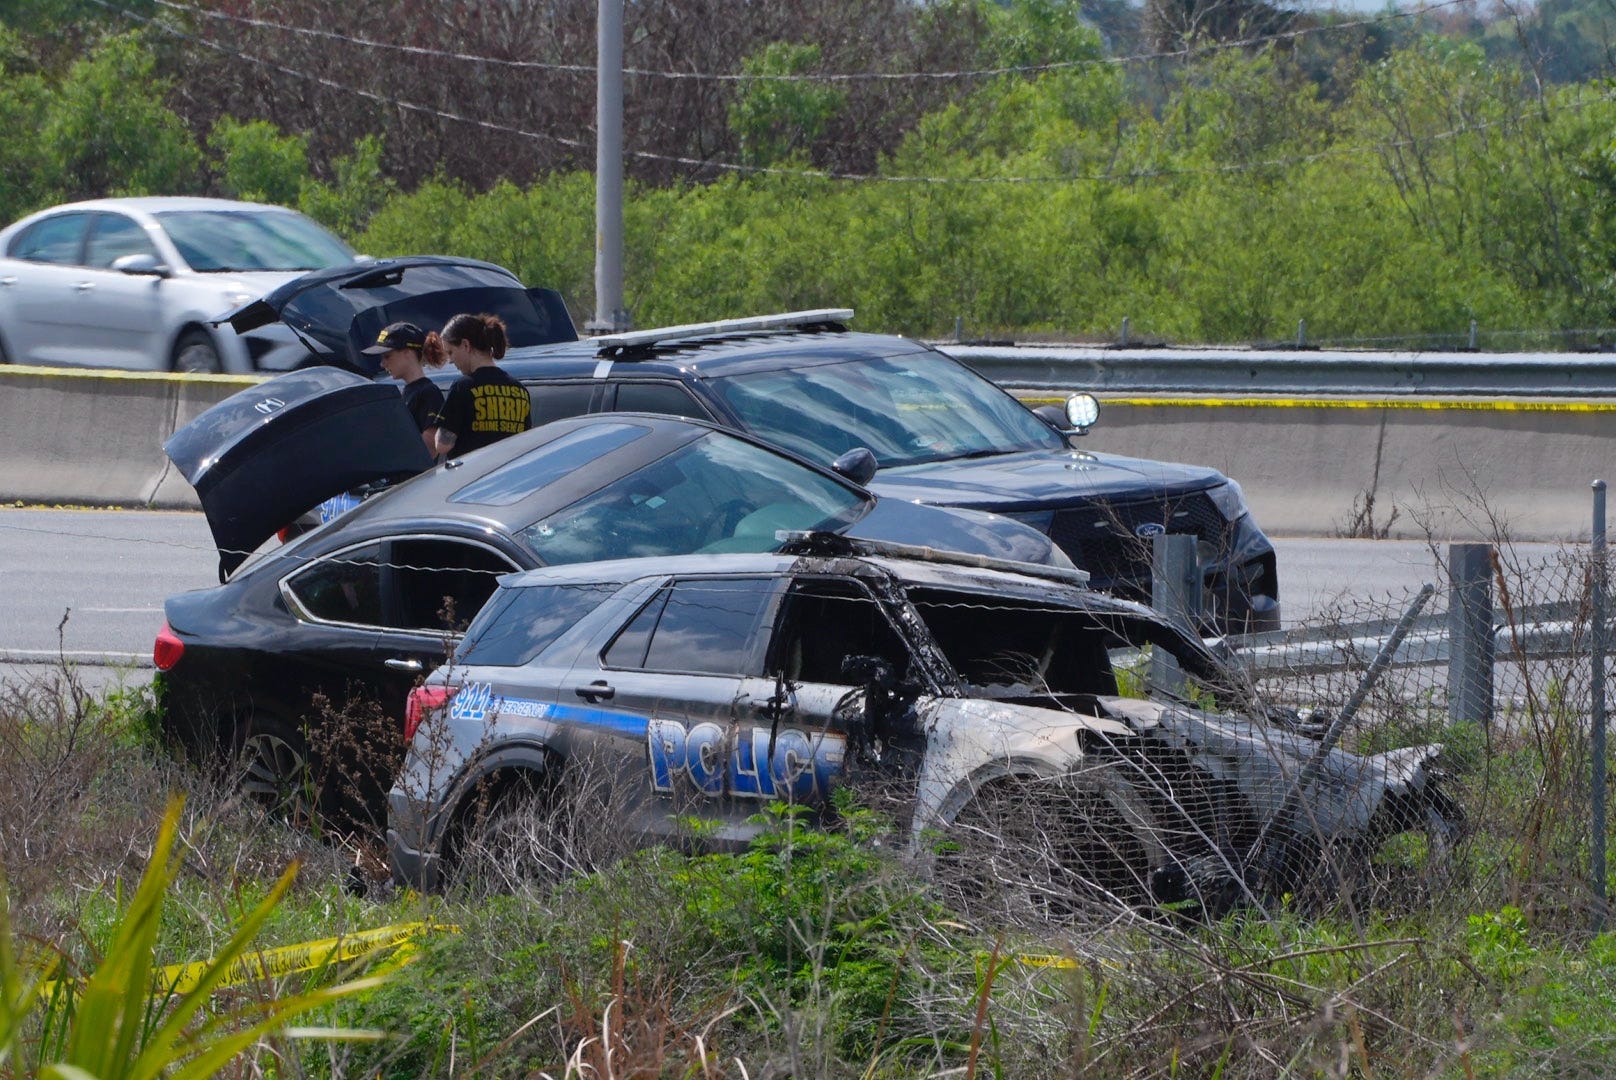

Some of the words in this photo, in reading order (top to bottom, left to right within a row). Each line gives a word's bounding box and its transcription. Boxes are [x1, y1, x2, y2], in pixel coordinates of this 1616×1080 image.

[472, 420, 499, 432] CRIME
[451, 681, 492, 719] 911
[648, 718, 848, 801] POLICE
